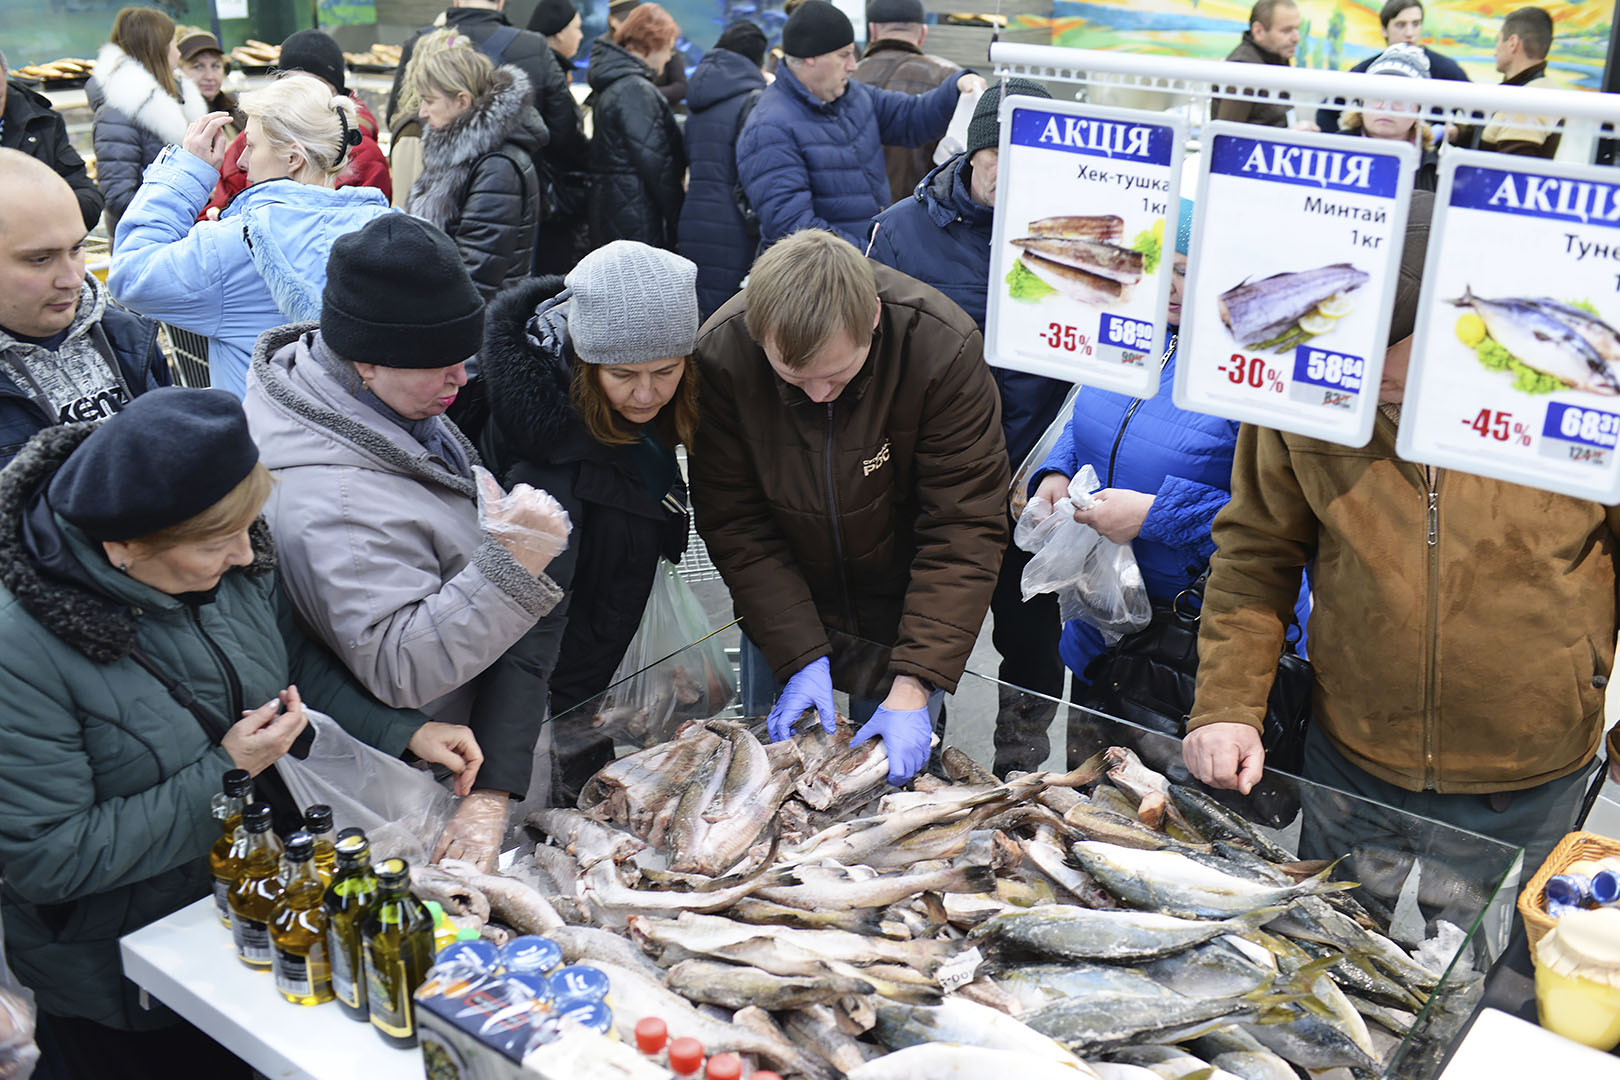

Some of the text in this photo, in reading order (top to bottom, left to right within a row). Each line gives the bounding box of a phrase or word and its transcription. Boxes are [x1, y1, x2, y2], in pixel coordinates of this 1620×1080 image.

[1038, 115, 1153, 158] АКЦІЯ
[1077, 164, 1170, 192] Хек-тушка
[1241, 142, 1375, 189] АКЦІЯ
[1303, 196, 1387, 223] Минтай
